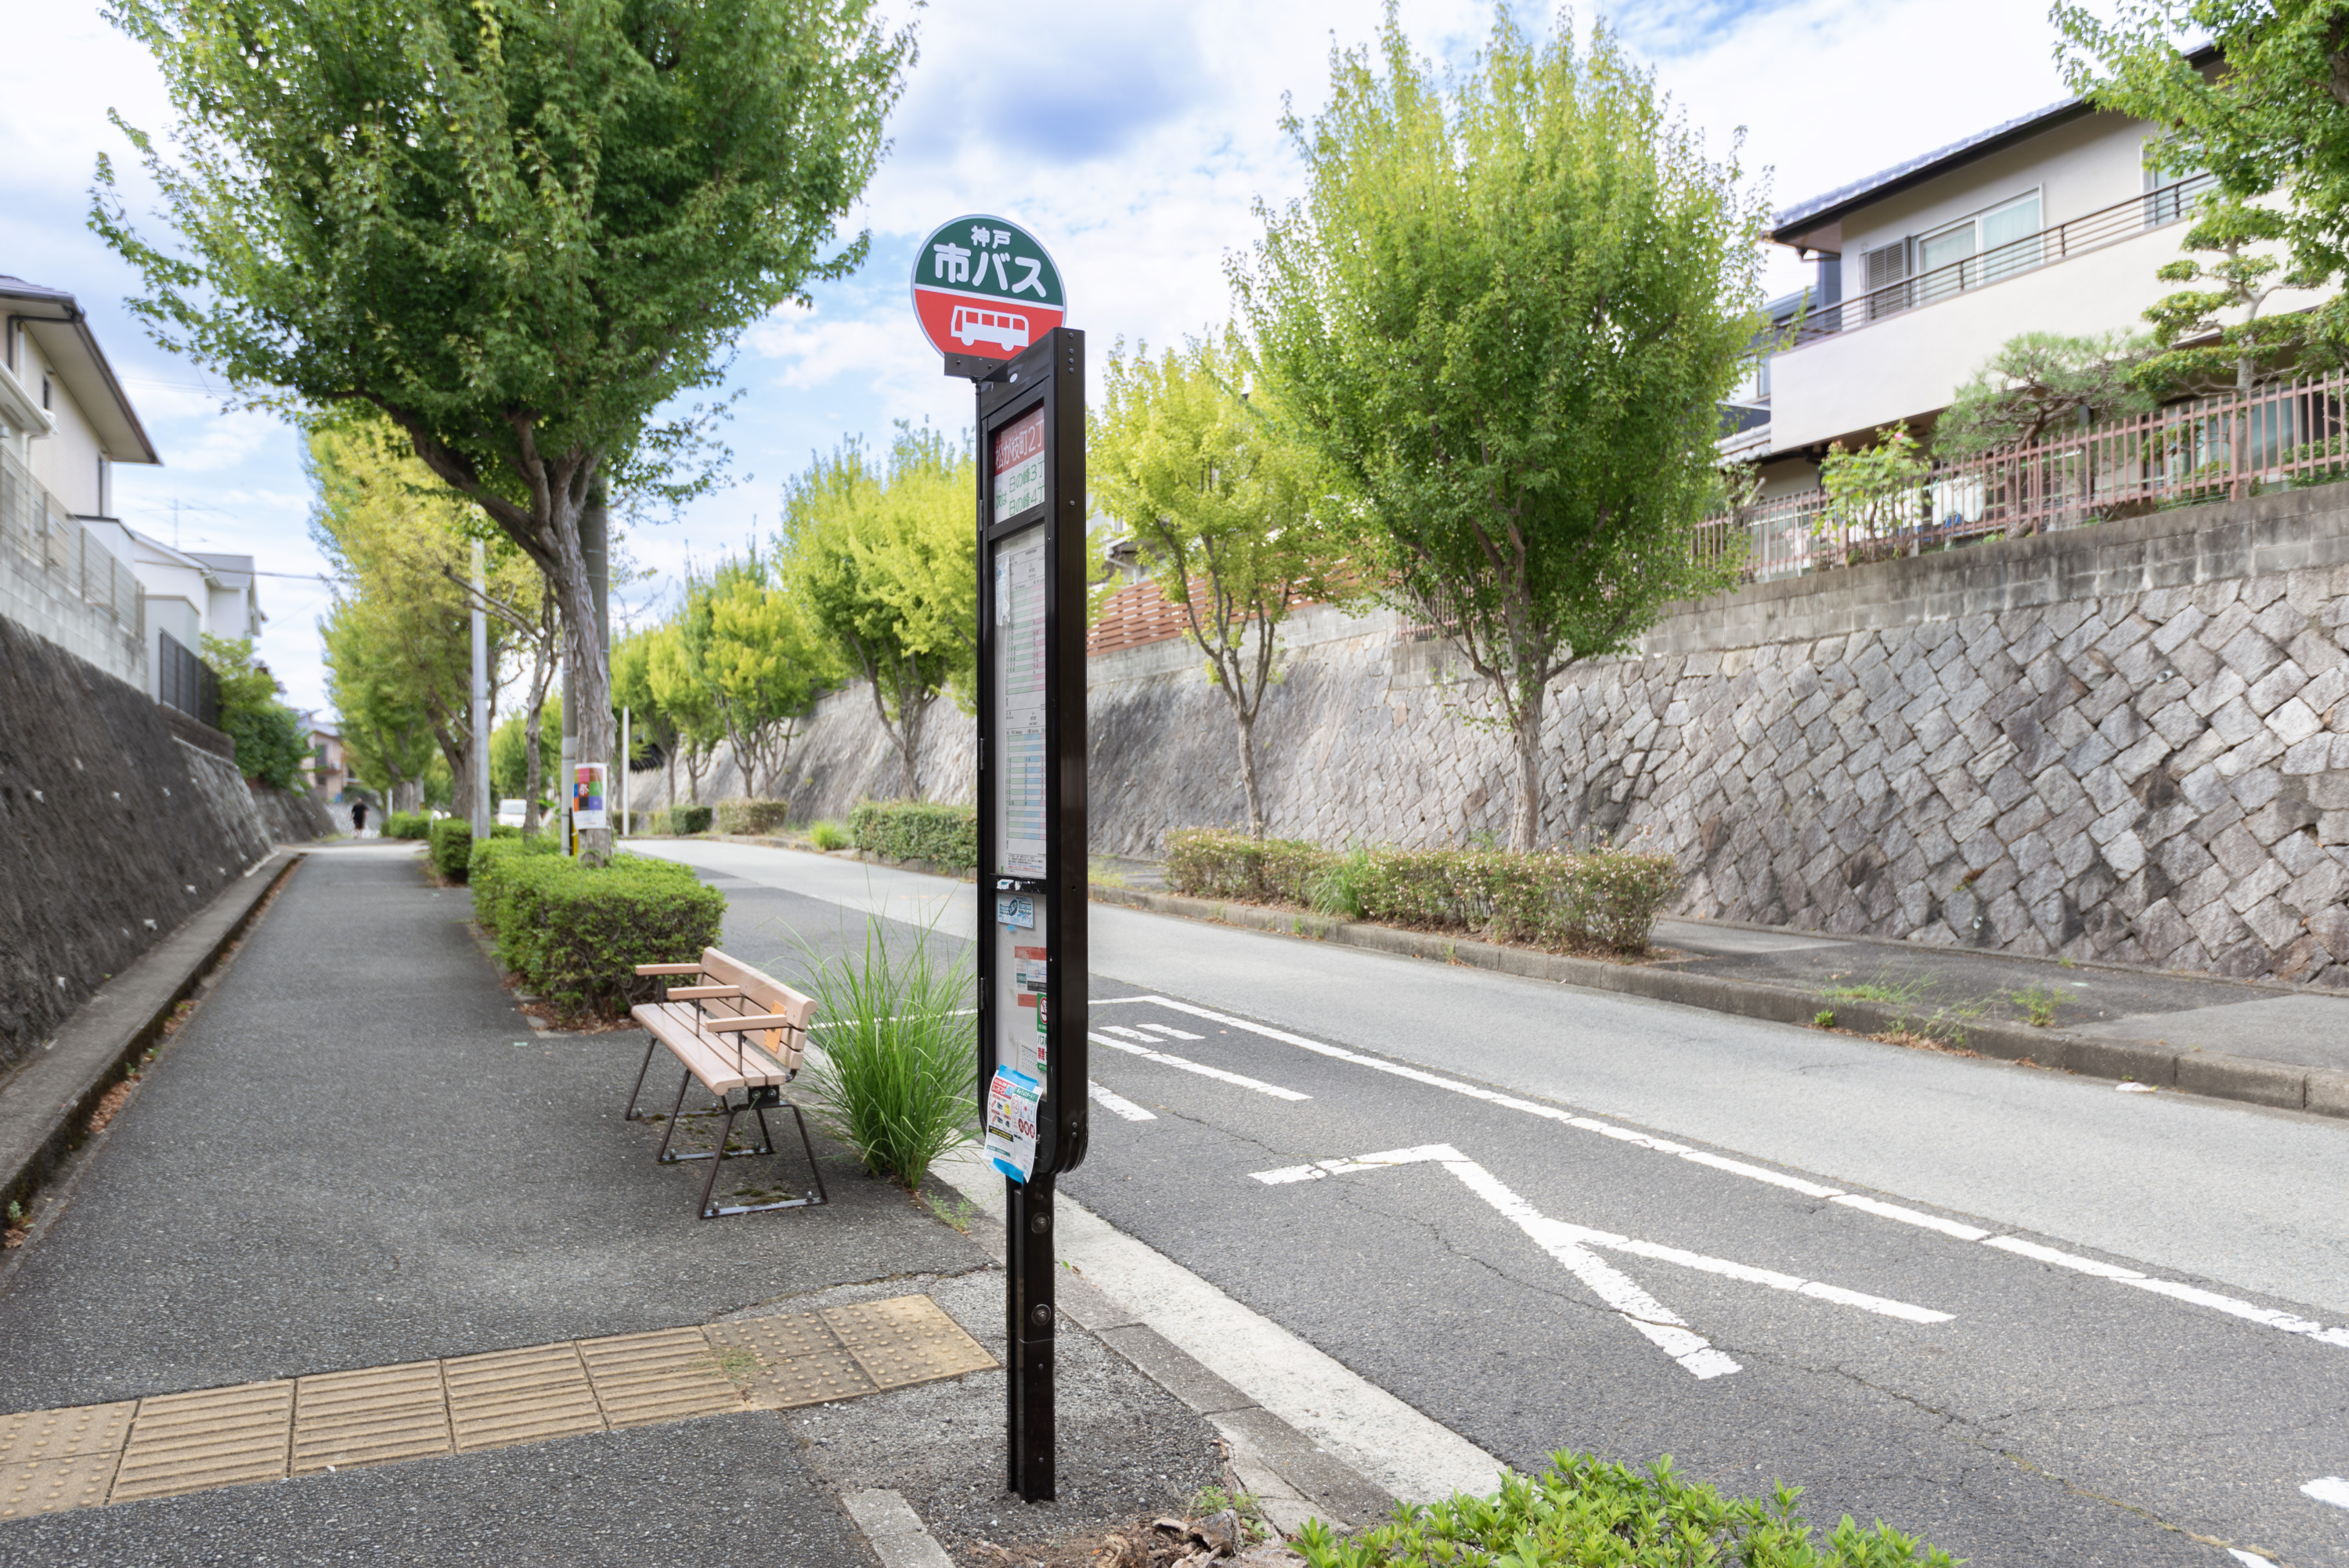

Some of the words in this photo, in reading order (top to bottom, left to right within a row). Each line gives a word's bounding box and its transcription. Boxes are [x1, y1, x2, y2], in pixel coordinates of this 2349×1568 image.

[971, 225, 1011, 249] 神戸
[933, 242, 1047, 297] 市バス
[996, 492, 1007, 509] 次は
